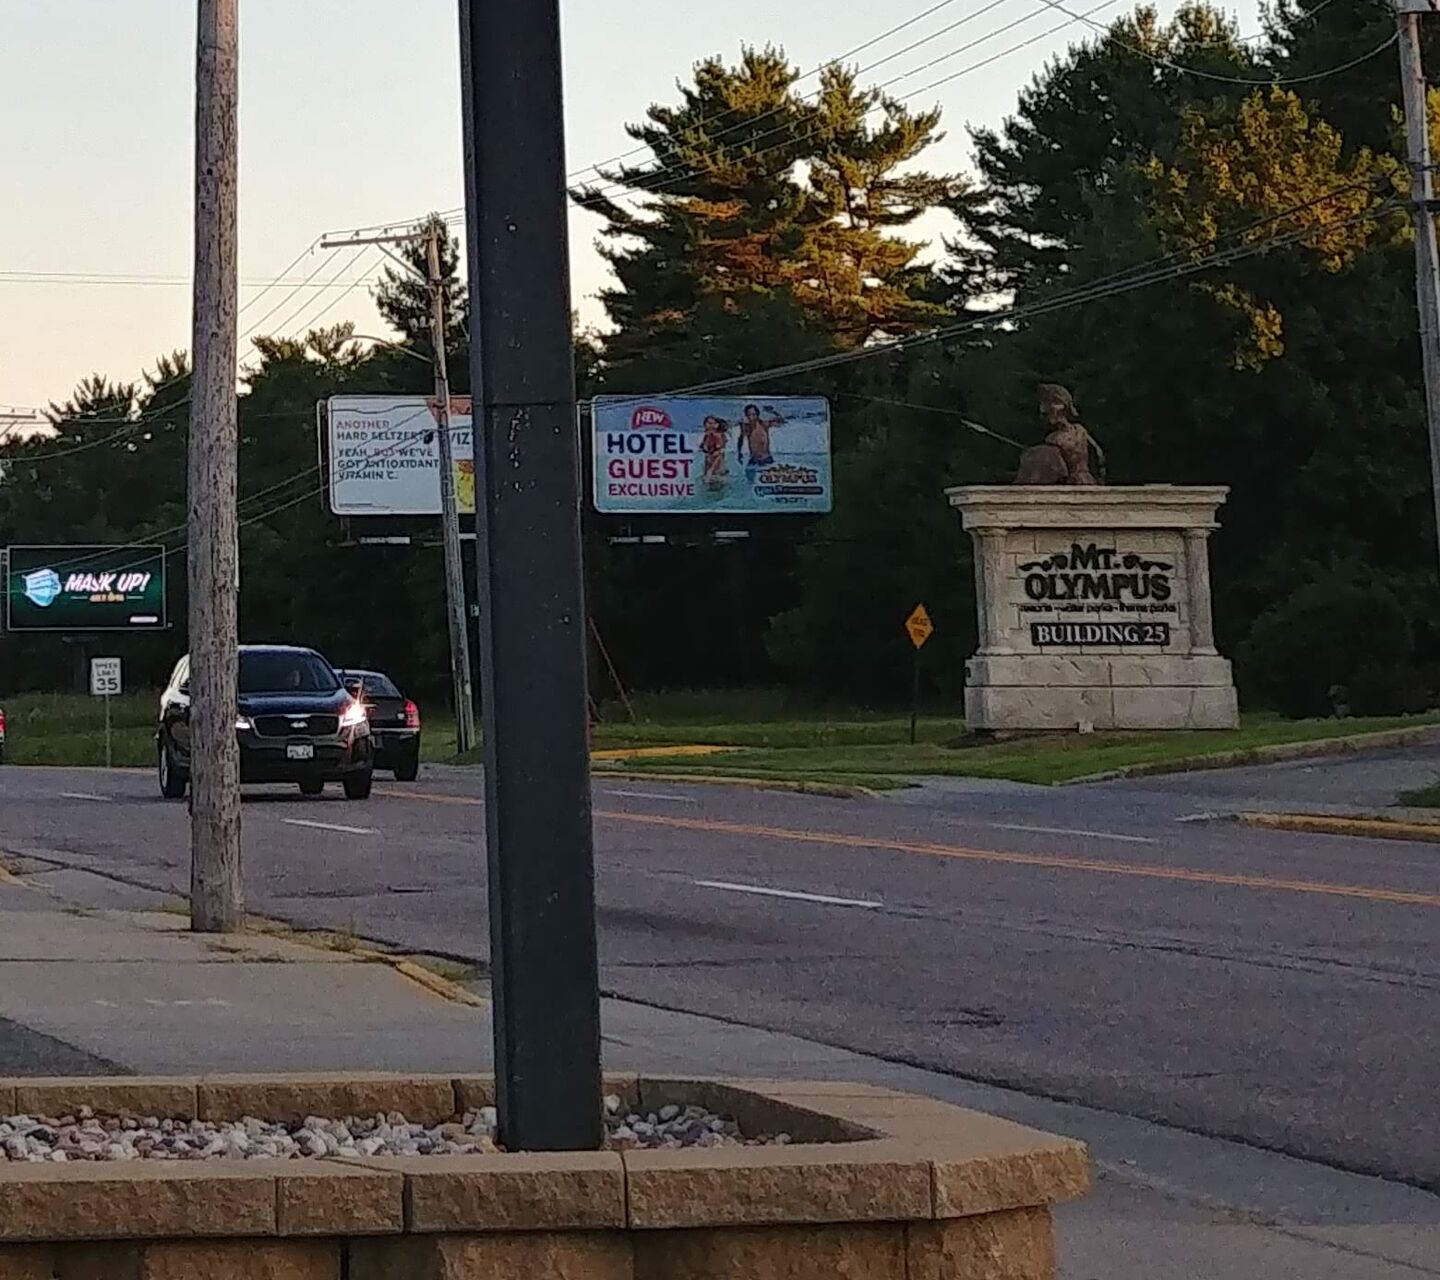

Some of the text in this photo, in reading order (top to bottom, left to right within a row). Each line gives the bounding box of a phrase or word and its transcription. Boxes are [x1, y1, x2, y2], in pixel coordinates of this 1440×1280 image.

[336, 420, 390, 429] ANOTHER
[337, 432, 368, 440] HARD
[607, 433, 694, 454] HOTEL
[608, 459, 693, 479] GUEST
[608, 483, 695, 496] EXCLUSIVE
[65, 572, 152, 592] MASK UP!
[1025, 573, 1171, 601] OLYMPUS
[1037, 625, 1165, 643] BUILDING 25
[96, 678, 118, 691] 35
